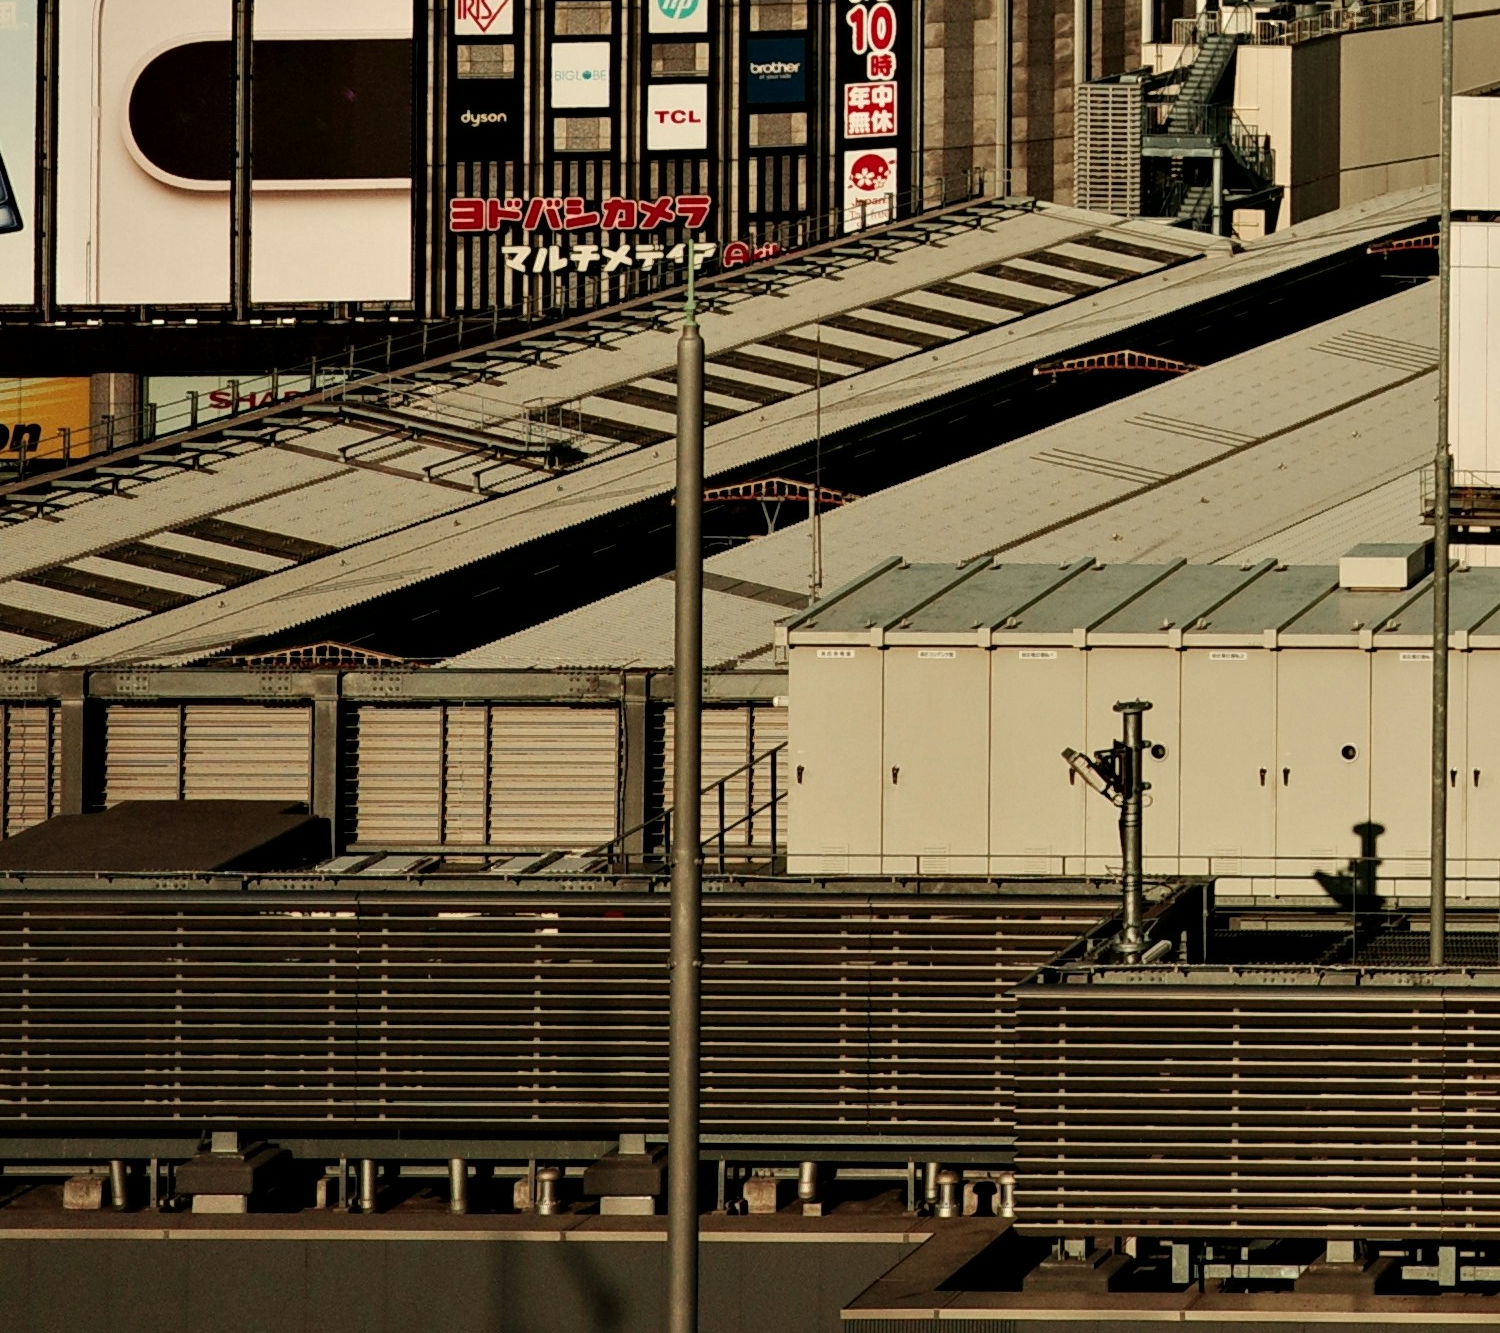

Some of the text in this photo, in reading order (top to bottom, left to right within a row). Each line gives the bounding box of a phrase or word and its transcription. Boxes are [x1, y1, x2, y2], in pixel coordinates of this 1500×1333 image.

[750, 61, 801, 75] brother
[848, 85, 893, 110] 年中
[460, 109, 507, 127] dyson
[655, 110, 701, 124] TCL
[848, 109, 894, 134] 無休
[450, 194, 712, 232] ヨドバシカメラ
[501, 243, 717, 273] マルチメディア
